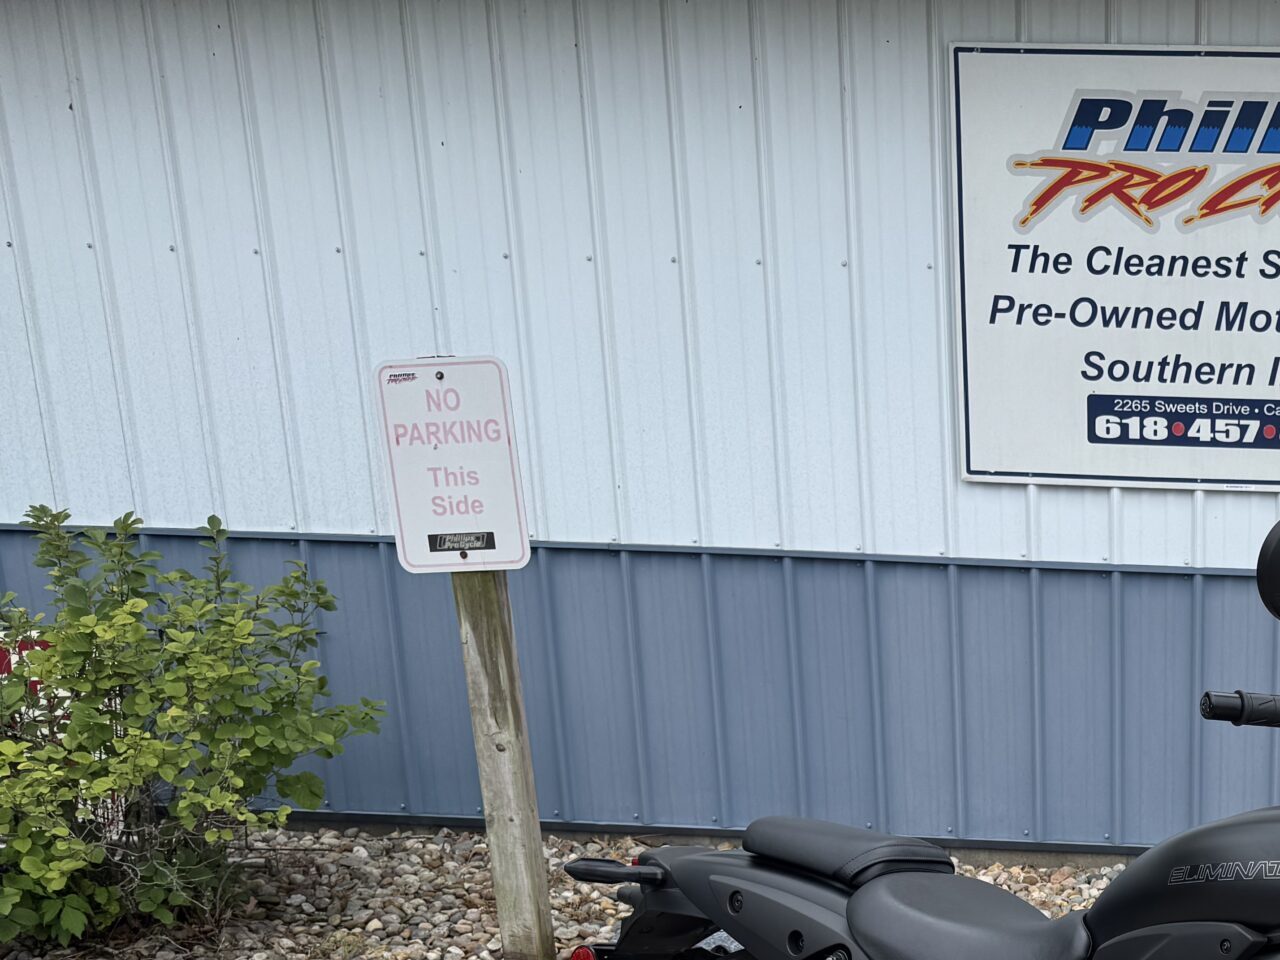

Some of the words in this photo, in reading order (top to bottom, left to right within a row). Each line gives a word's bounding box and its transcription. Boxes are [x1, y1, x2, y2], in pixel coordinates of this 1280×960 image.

[1013, 157, 1208, 227] PRO
[1008, 244, 1072, 275] The
[1087, 246, 1248, 279] Cleanest
[989, 295, 1204, 331] Pre-Owned
[1081, 350, 1255, 386] Southern
[425, 388, 461, 412] NO
[1114, 399, 1150, 412] 2265
[1155, 400, 1207, 414] Sweets
[1212, 402, 1250, 415] Drive
[394, 418, 501, 446] PARKING
[427, 466, 480, 487] This
[431, 495, 485, 516] Side
